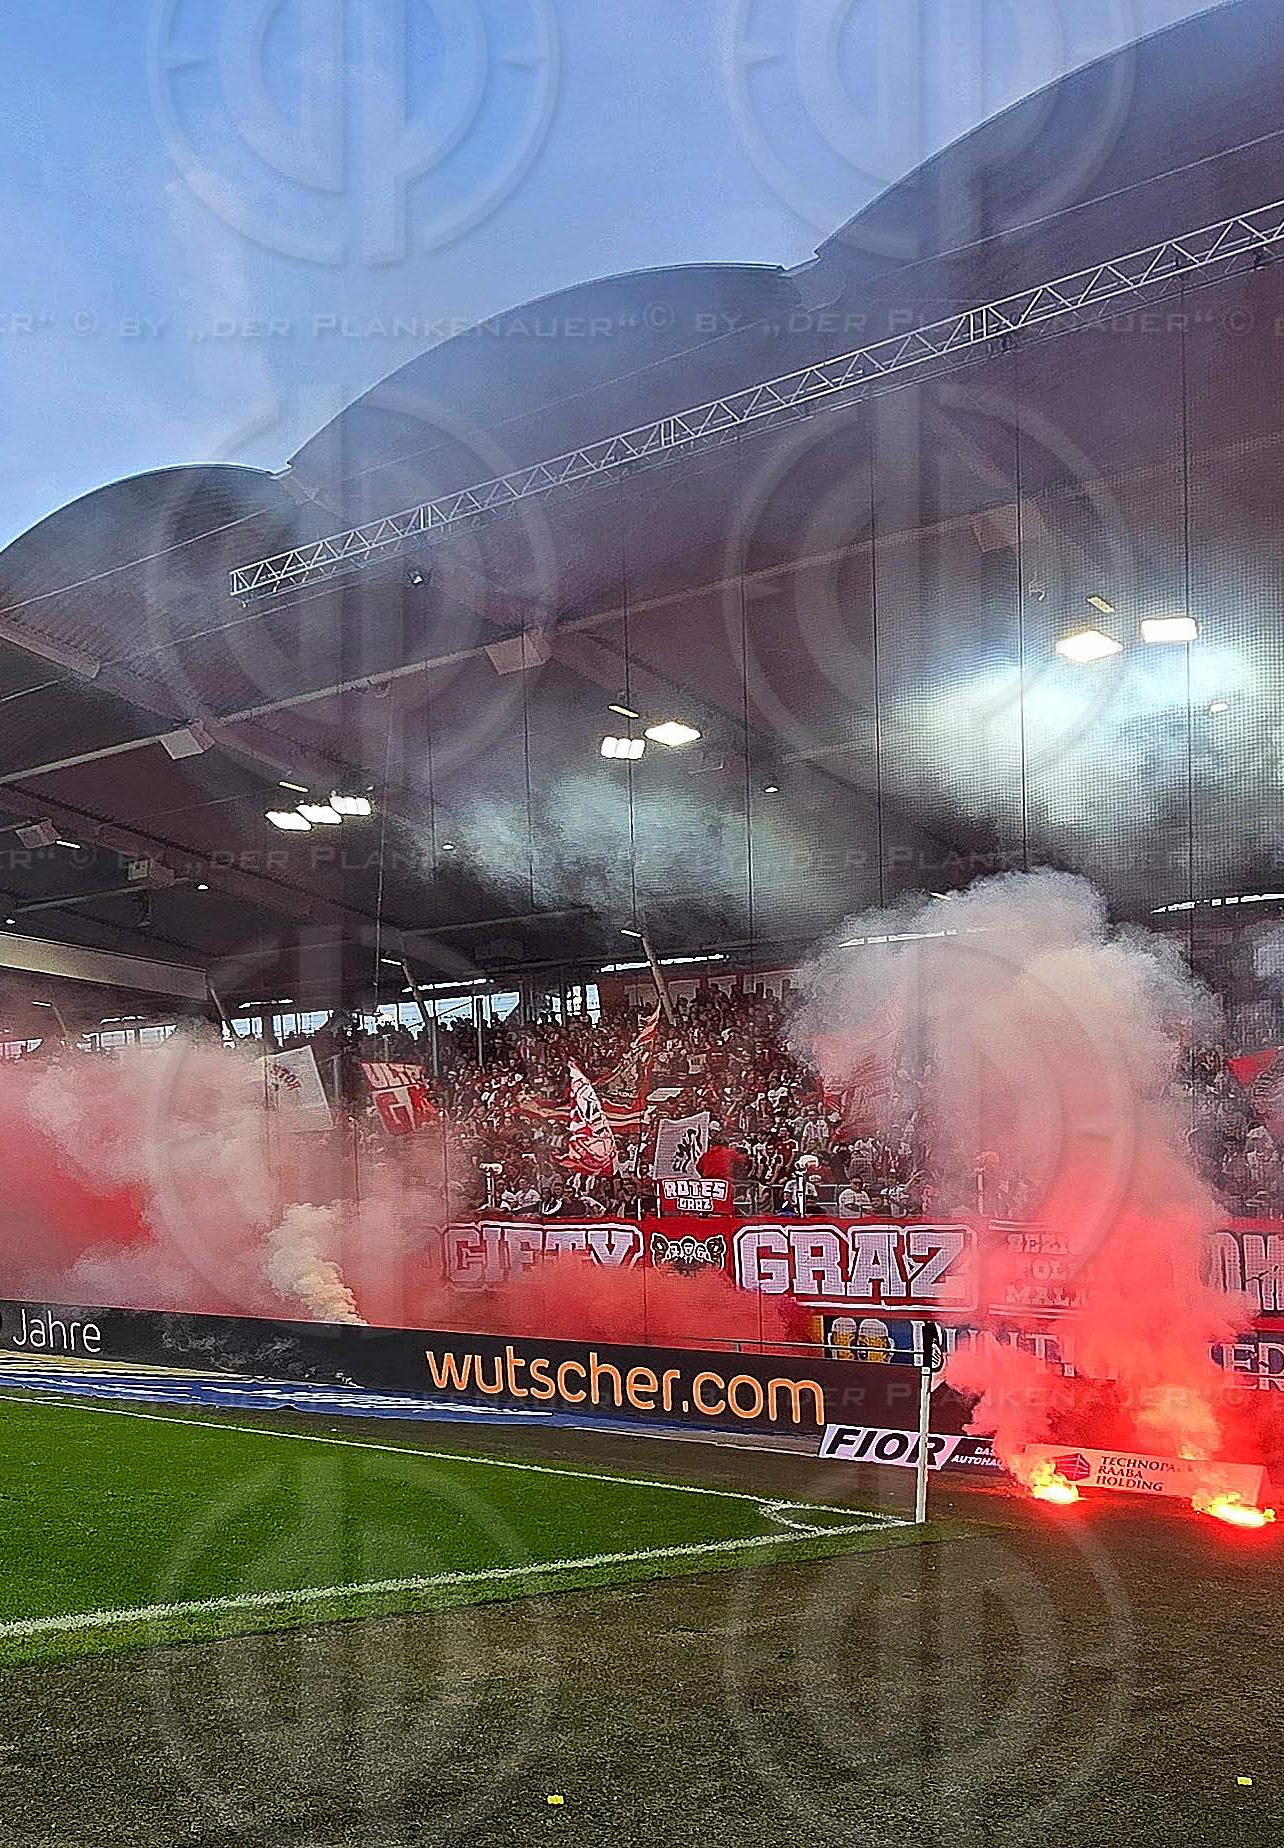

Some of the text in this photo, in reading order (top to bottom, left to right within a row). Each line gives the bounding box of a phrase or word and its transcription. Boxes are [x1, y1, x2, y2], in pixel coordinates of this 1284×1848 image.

[664, 1181, 725, 1198] ROTES
[679, 1198, 712, 1211] GRAZ
[739, 1227, 966, 1299] GRAZ
[13, 1313, 102, 1353] Jahre
[425, 1345, 826, 1425] wutscher.com
[825, 1427, 948, 1467] FIOR
[1096, 1475, 1164, 1493] HOLDING
[1098, 1465, 1144, 1480] RAABA
